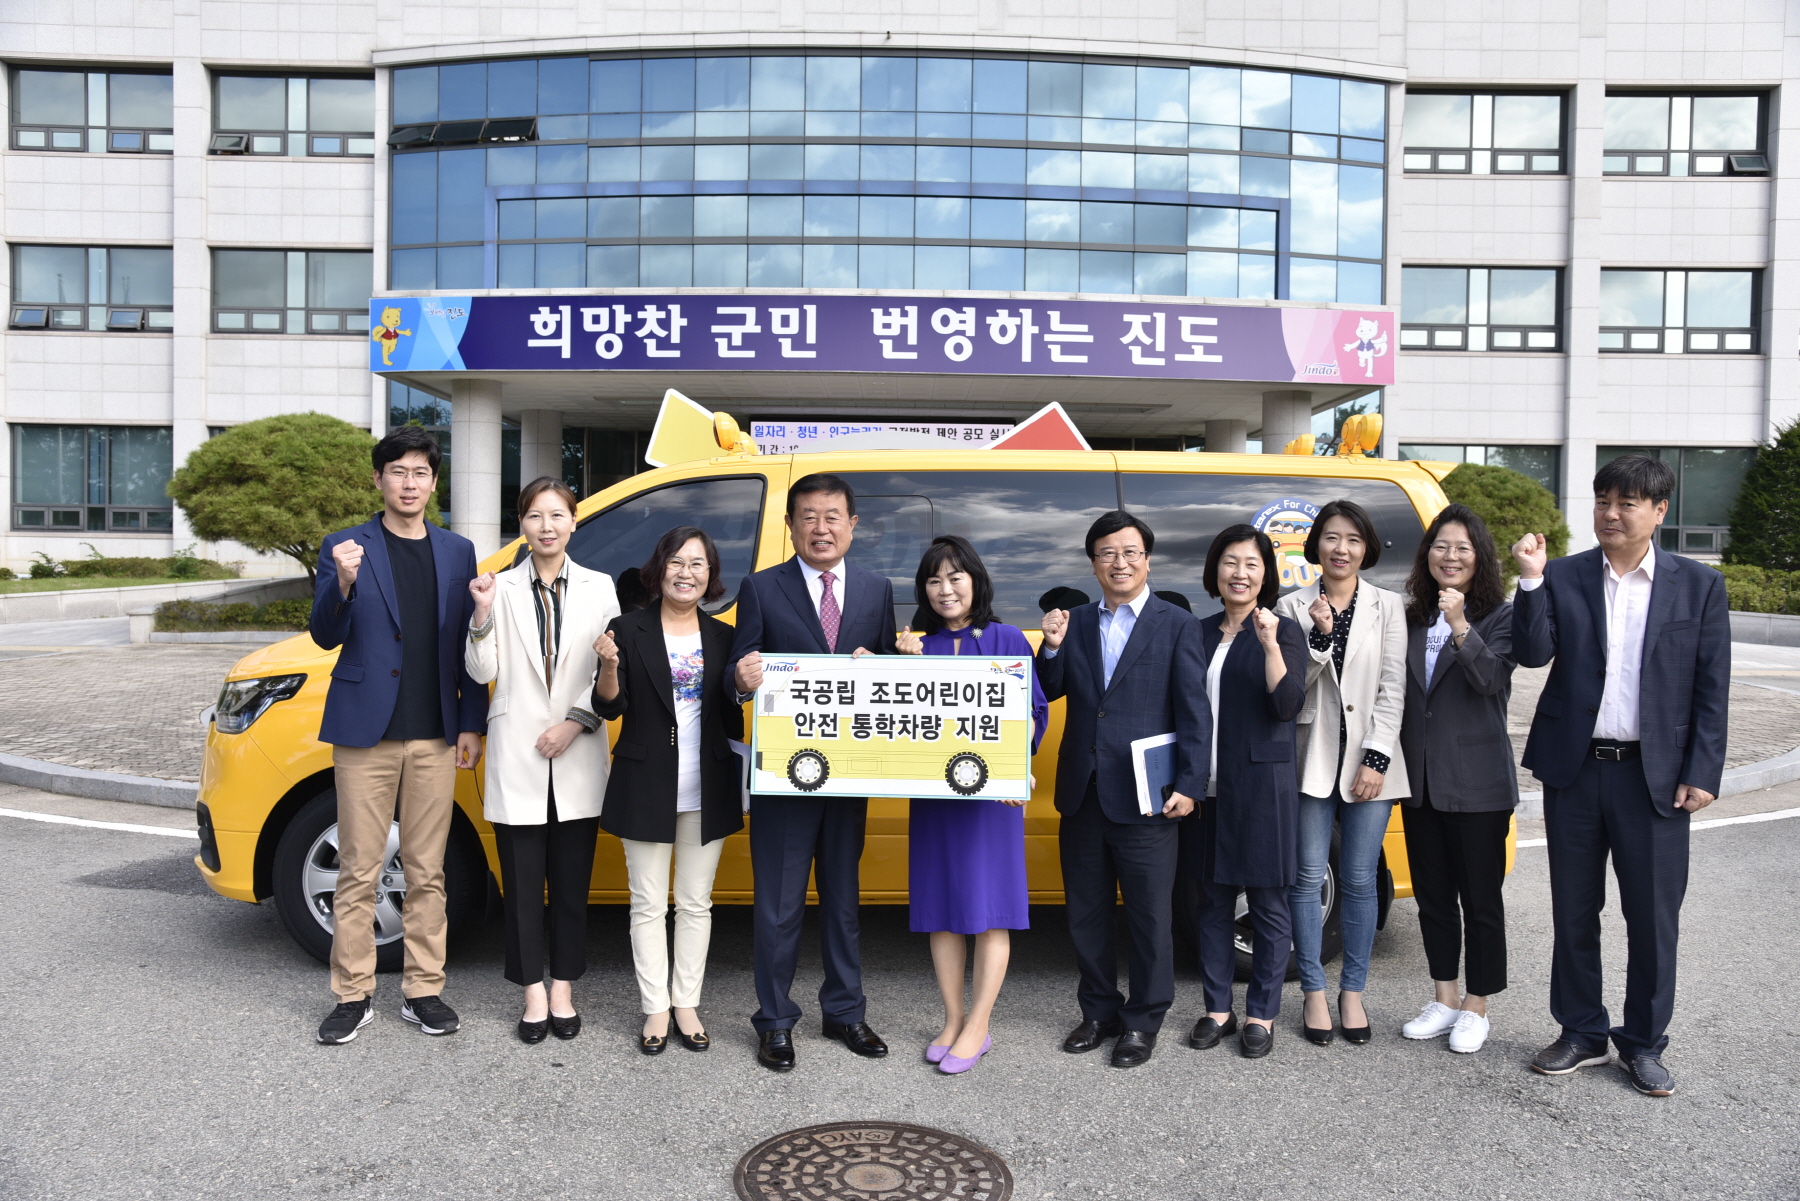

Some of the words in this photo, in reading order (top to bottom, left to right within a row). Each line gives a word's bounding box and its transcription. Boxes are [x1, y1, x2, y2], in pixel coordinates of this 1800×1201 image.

[527, 304, 688, 360] 희망찬
[711, 304, 818, 360] 군민
[871, 305, 1094, 363] 번영하는
[1119, 312, 1223, 367] 진도
[1301, 365, 1333, 376] Jindo
[754, 425, 786, 438] 일자리
[797, 425, 818, 438] 청년
[963, 428, 984, 440] 공모
[1254, 503, 1282, 532] tarex
[1283, 499, 1301, 509] For
[763, 663, 794, 673] Jindo
[790, 679, 855, 706] 국공립
[869, 681, 1006, 708] 조도어린이집
[794, 711, 839, 738] 안전
[851, 713, 942, 741] 통학차량
[956, 714, 1000, 741] 지원
